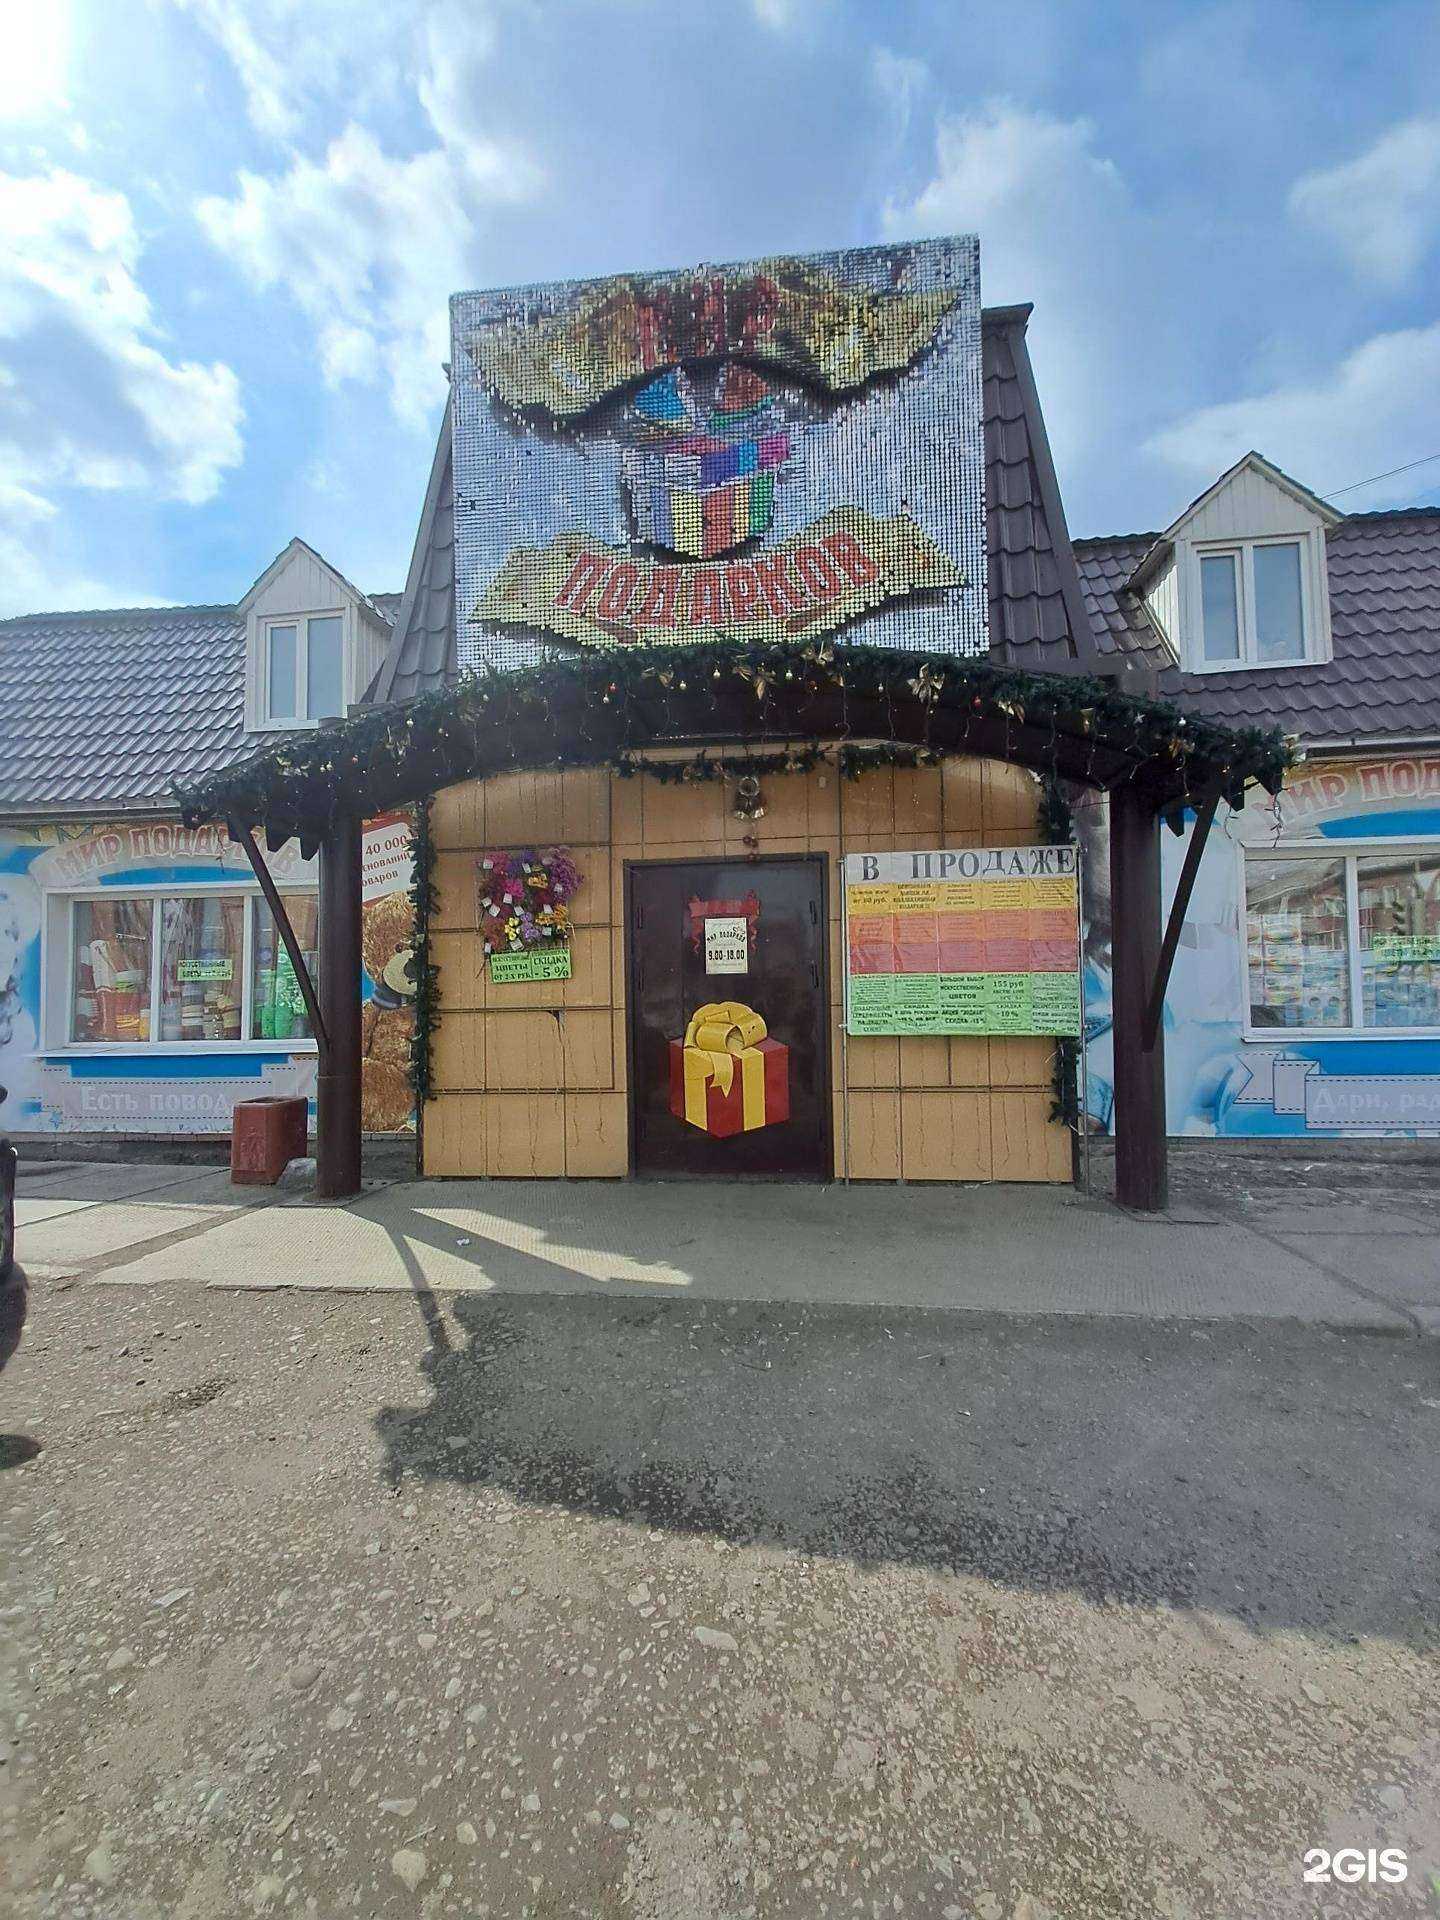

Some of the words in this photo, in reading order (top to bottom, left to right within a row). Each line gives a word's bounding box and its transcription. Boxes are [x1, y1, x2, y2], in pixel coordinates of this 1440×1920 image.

[551, 530, 879, 628] ПОДАРКОВ
[862, 855, 880, 880] В
[911, 848, 1075, 878] ПРОДАЖЕ
[533, 955, 567, 966] СКИДКА
